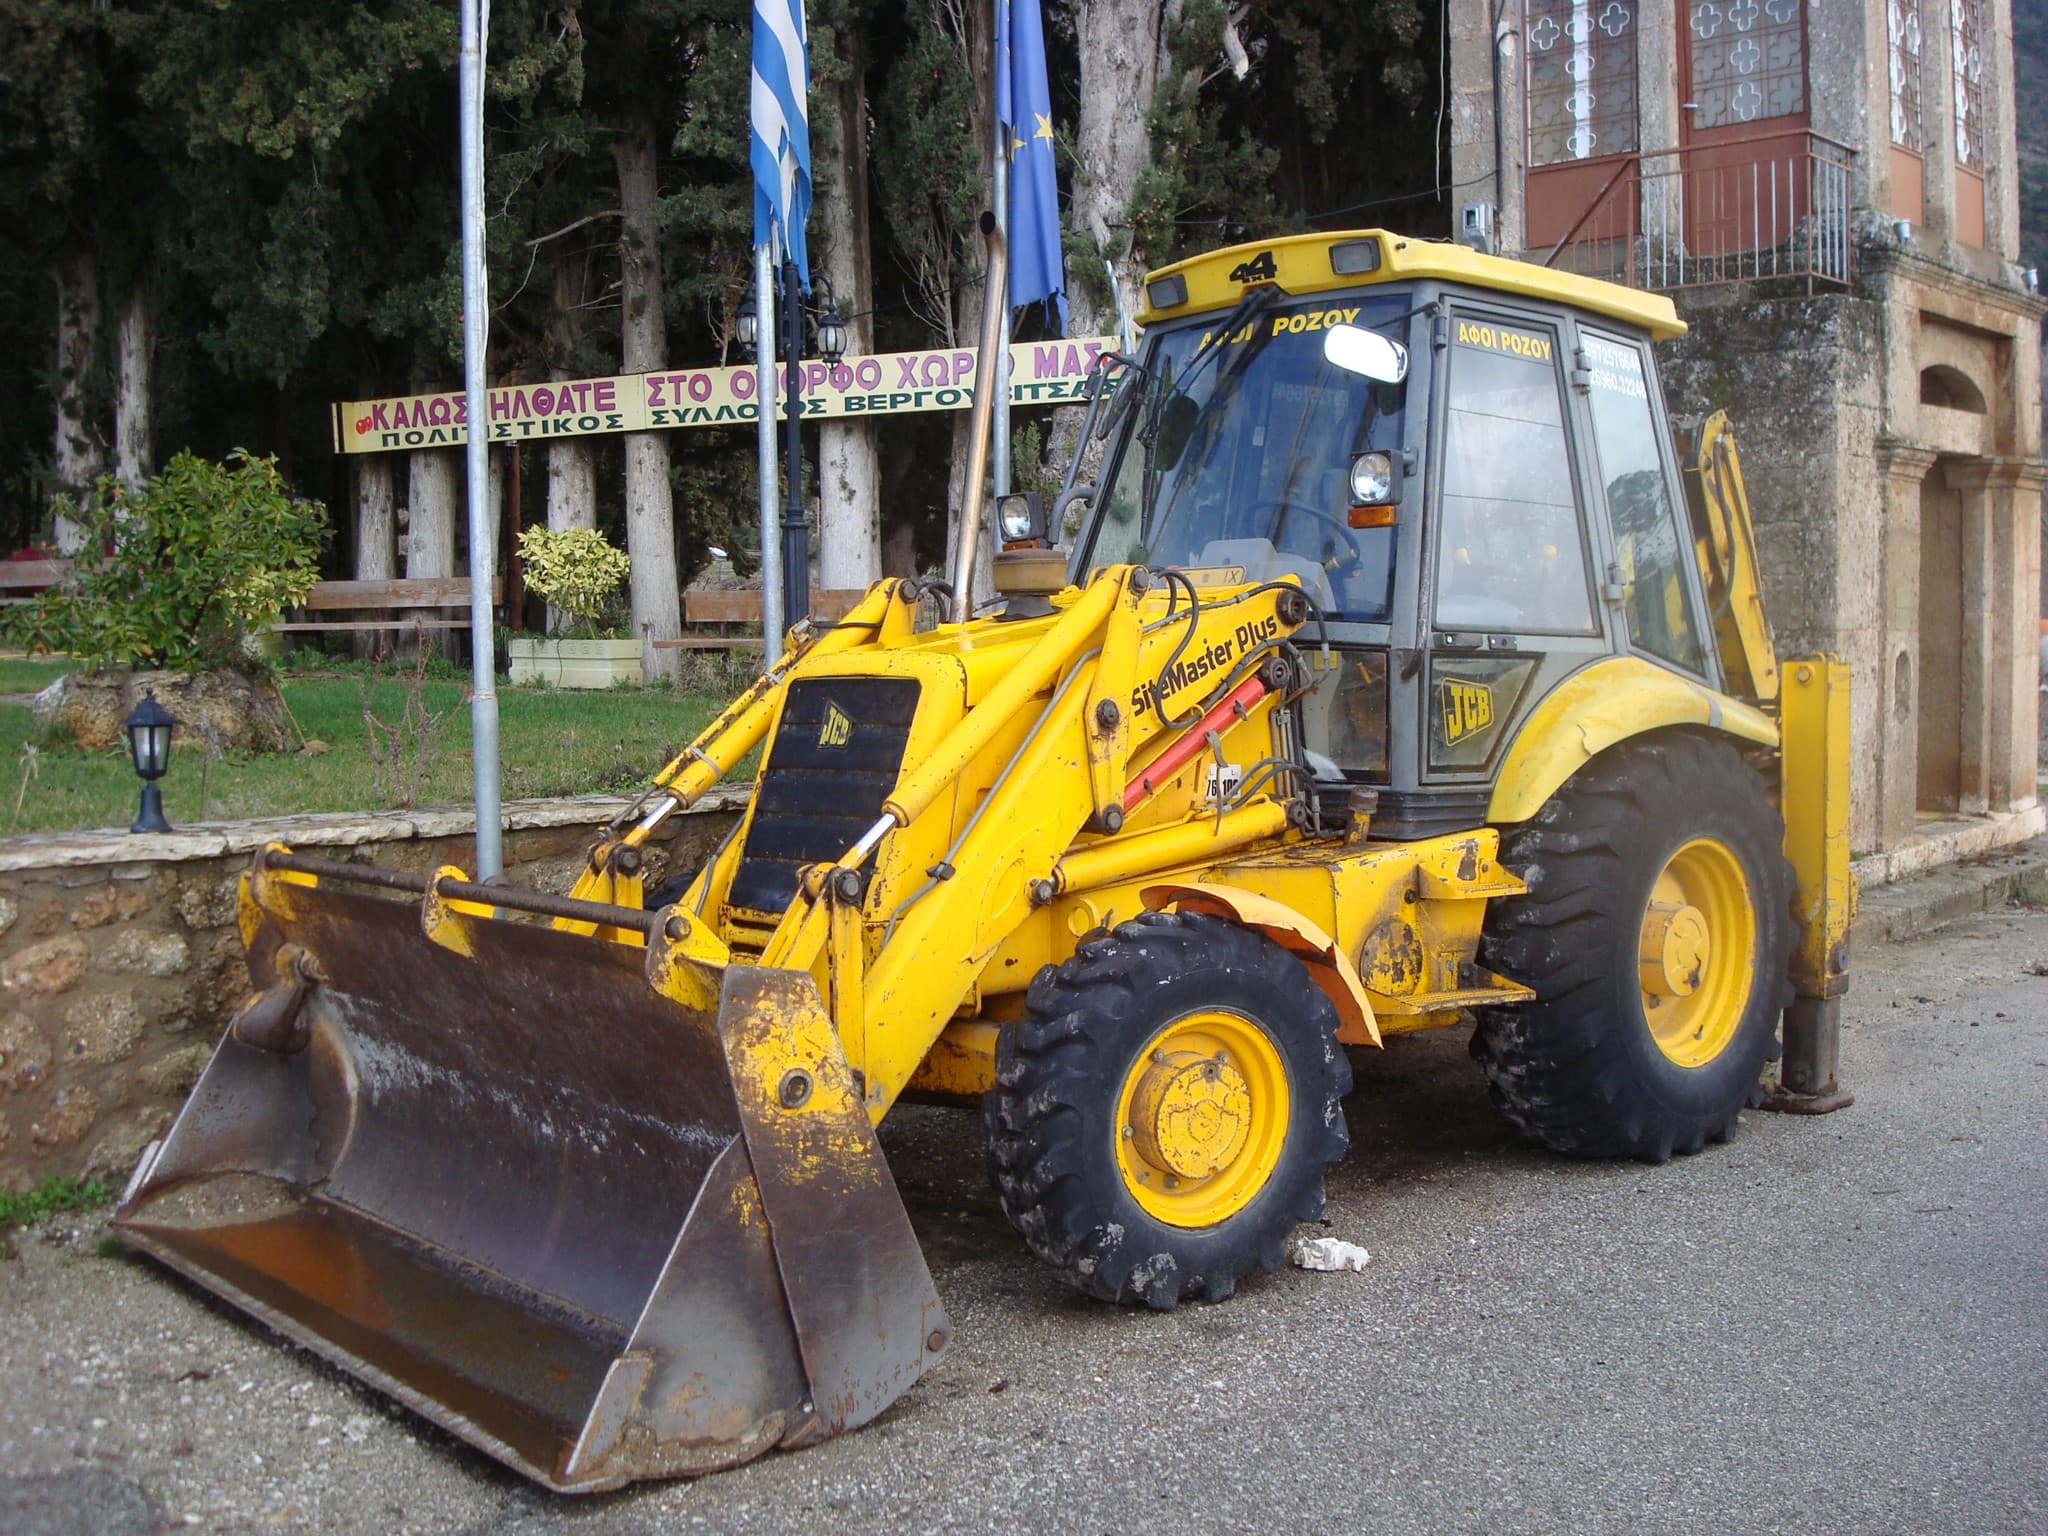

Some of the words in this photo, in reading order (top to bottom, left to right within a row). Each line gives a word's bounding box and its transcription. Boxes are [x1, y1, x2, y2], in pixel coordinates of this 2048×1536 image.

[1272, 308, 1361, 337] ΡΟΖΟΥ
[1459, 322, 1497, 349] ΑΦΟΙ
[1501, 332, 1550, 361] ΡΟΖΟΥ
[372, 395, 468, 431] ΚΑΛΩΣ
[490, 381, 616, 420] ΗΛΘΑΤΕ
[646, 373, 712, 407] ΣΤΟ
[1034, 342, 1102, 379] ΜΑΣ
[1235, 615, 1278, 654] Plus
[819, 705, 850, 745] JCB
[1447, 685, 1490, 739] JCB
